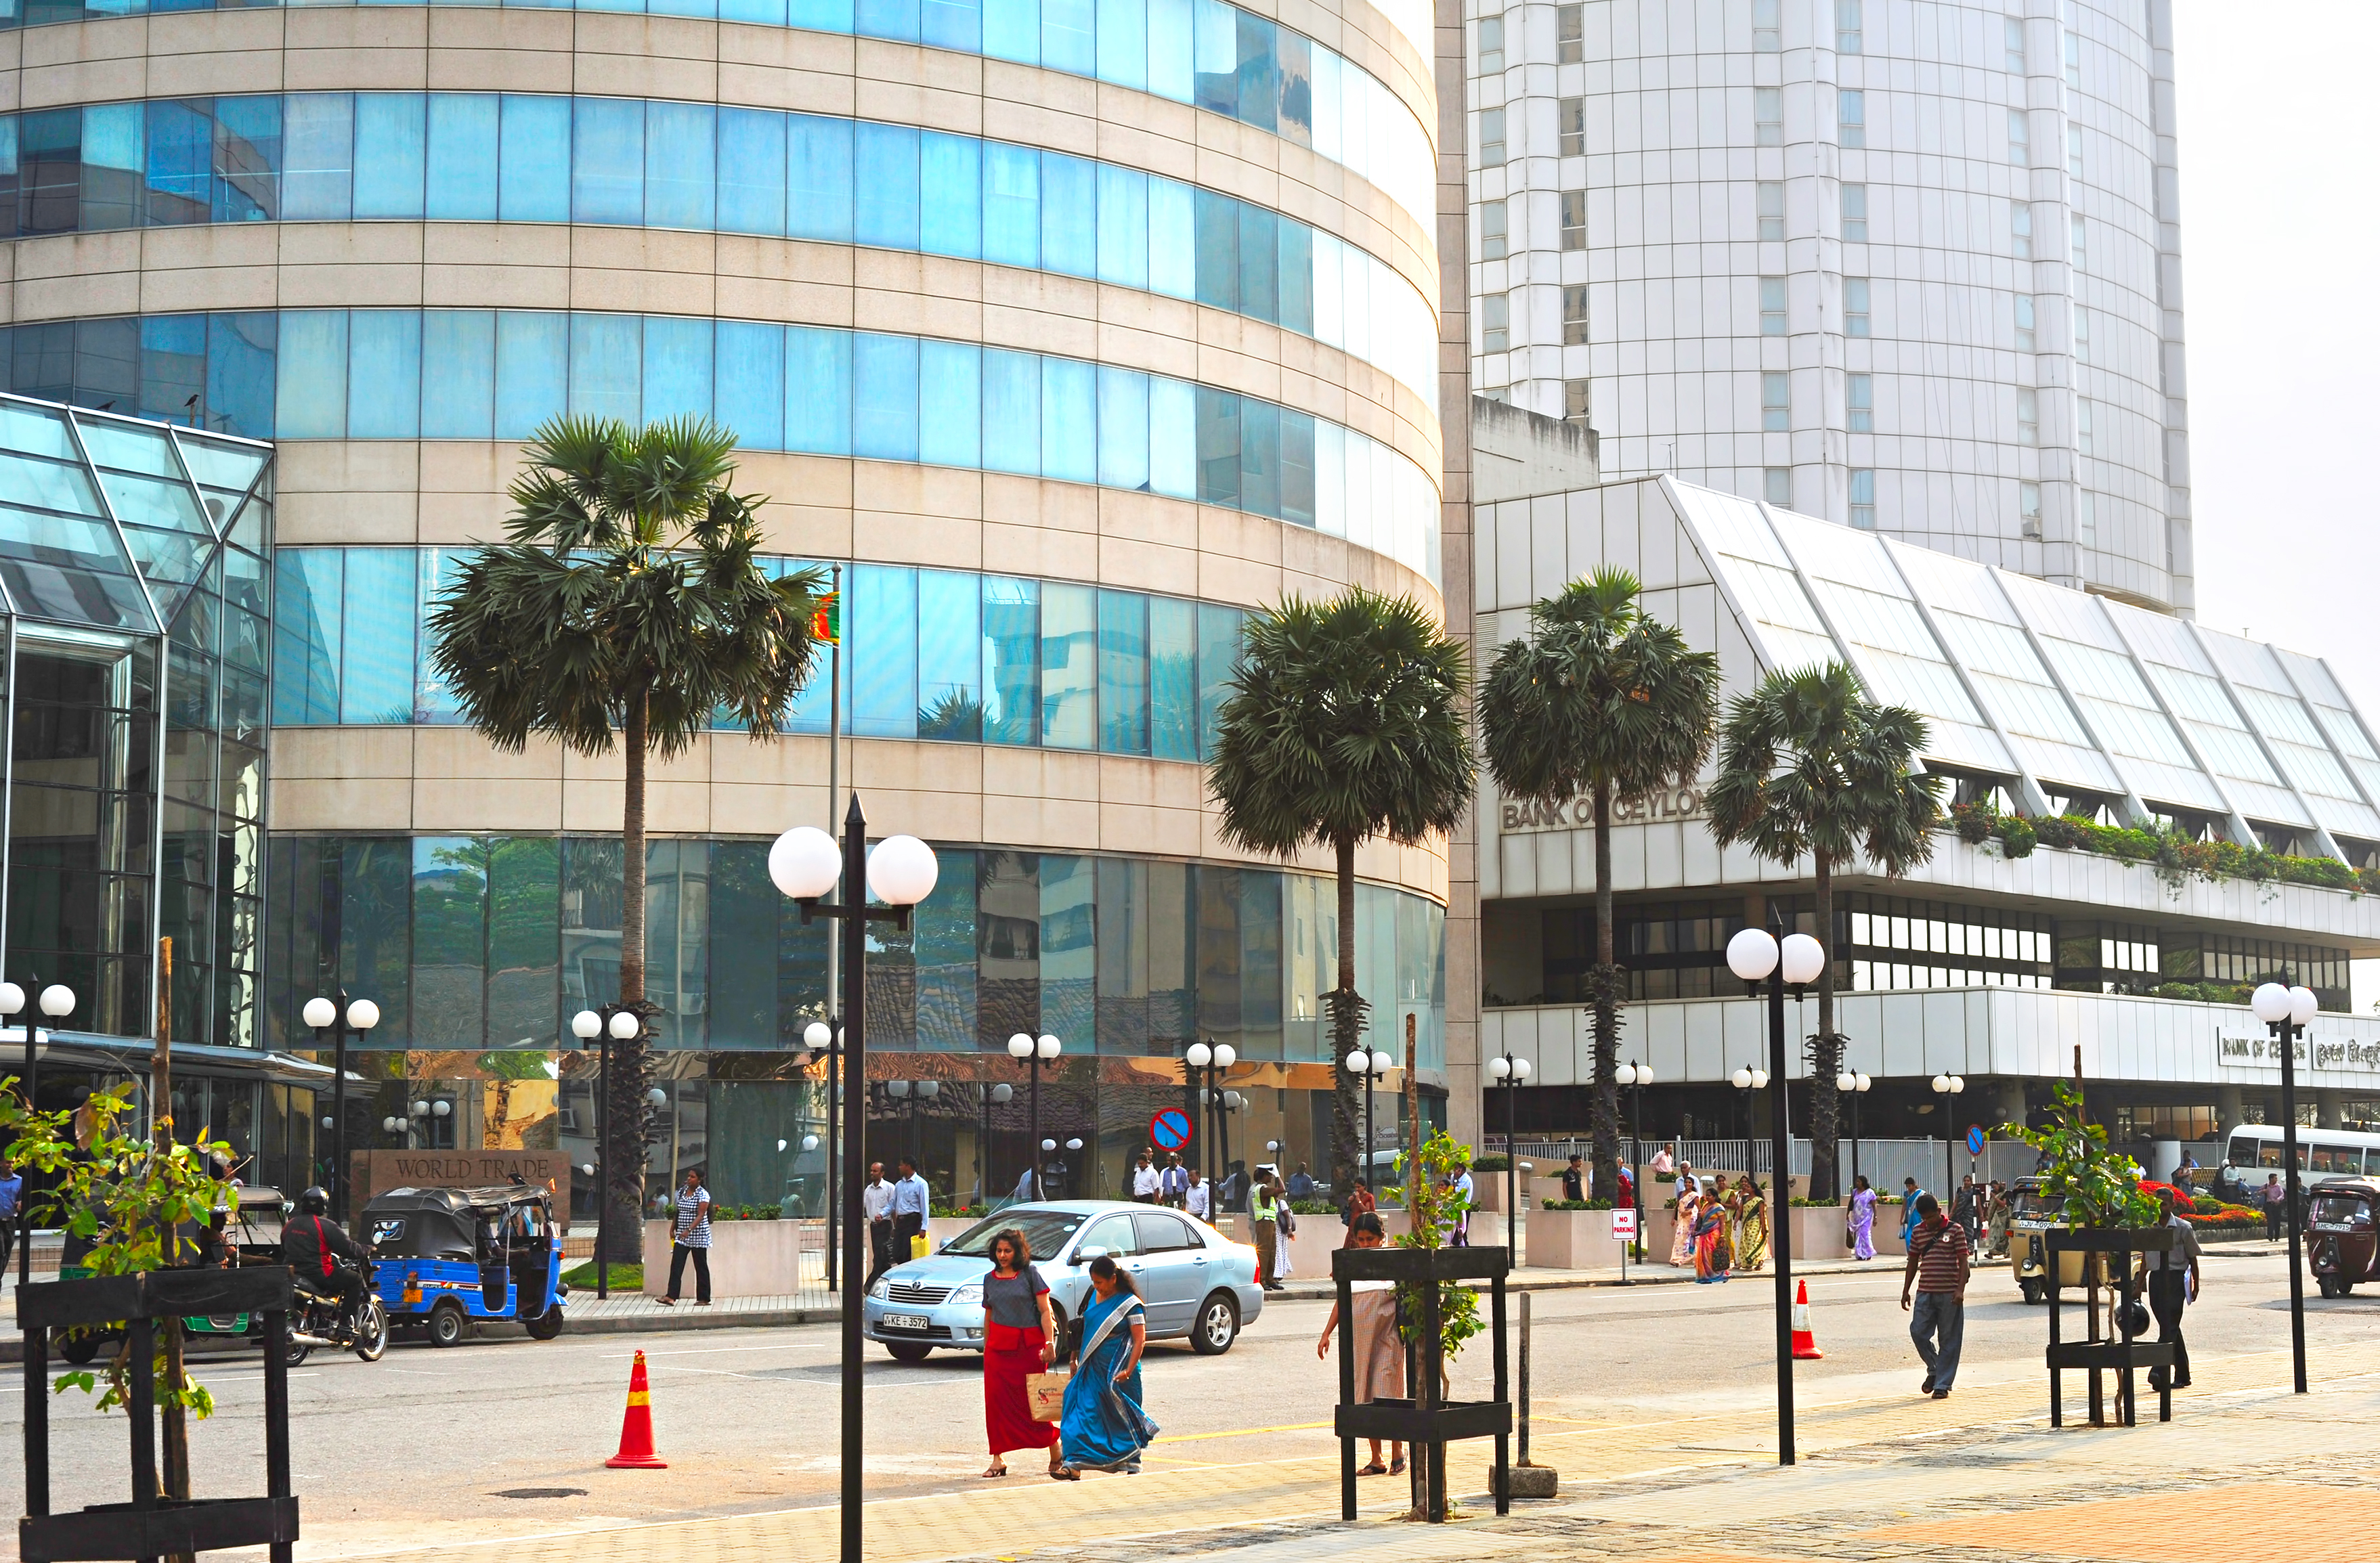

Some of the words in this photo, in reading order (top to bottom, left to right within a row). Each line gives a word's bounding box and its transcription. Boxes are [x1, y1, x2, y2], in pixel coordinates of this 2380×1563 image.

[1502, 803, 1567, 829] BANK
[2222, 1038, 2249, 1056] BANK
[2252, 1039, 2266, 1057] OF
[395, 1159, 471, 1179] WORLD
[479, 1159, 548, 1179] TRADE
